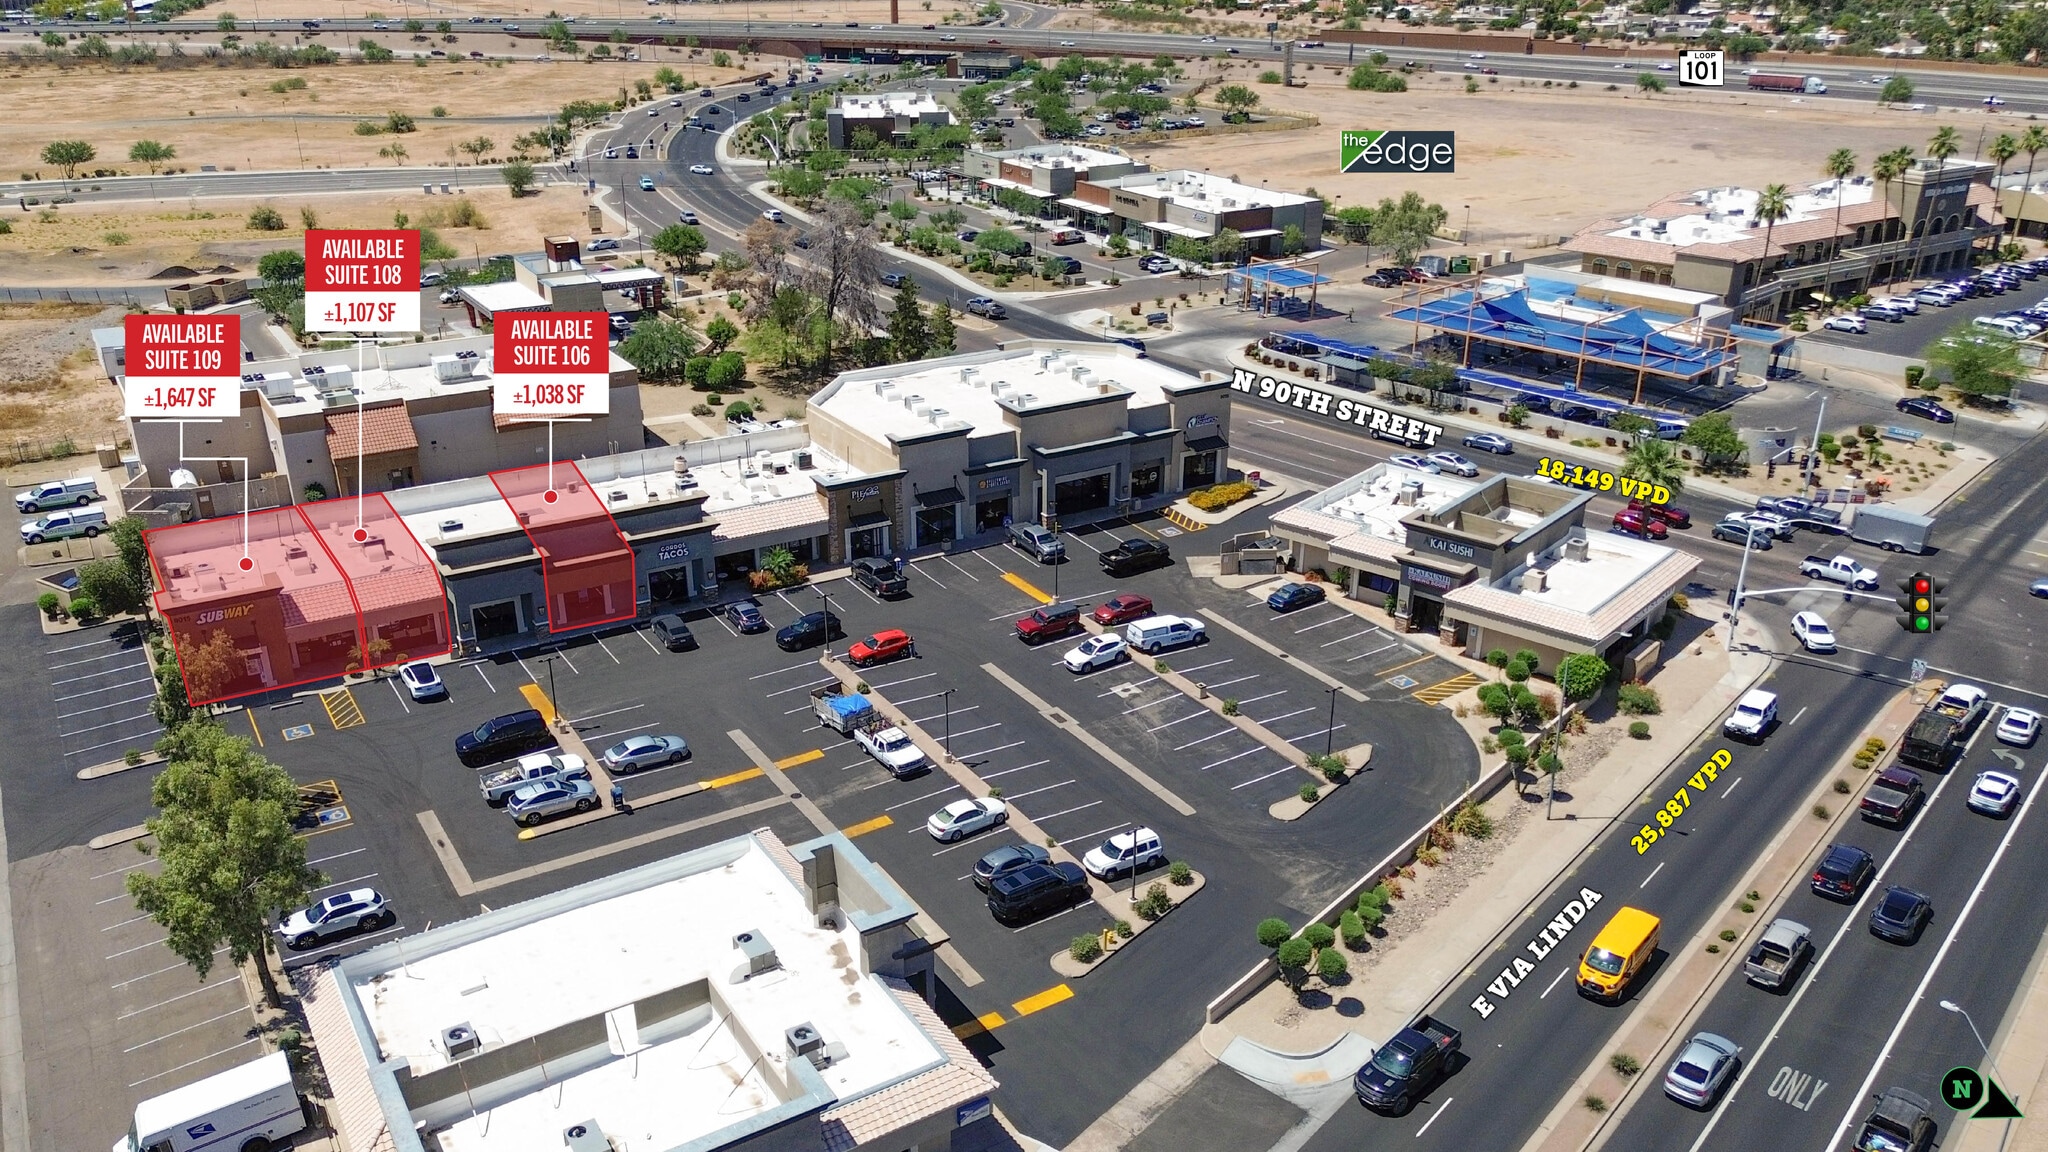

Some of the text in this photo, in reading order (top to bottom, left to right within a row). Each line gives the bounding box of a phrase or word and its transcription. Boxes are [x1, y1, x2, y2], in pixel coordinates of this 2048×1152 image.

[659, 548, 689, 560] TACOS
[1449, 543, 1474, 558] SUSHI
[196, 604, 254, 625] SUBWAY
[1767, 1066, 1829, 1112] ONLY
